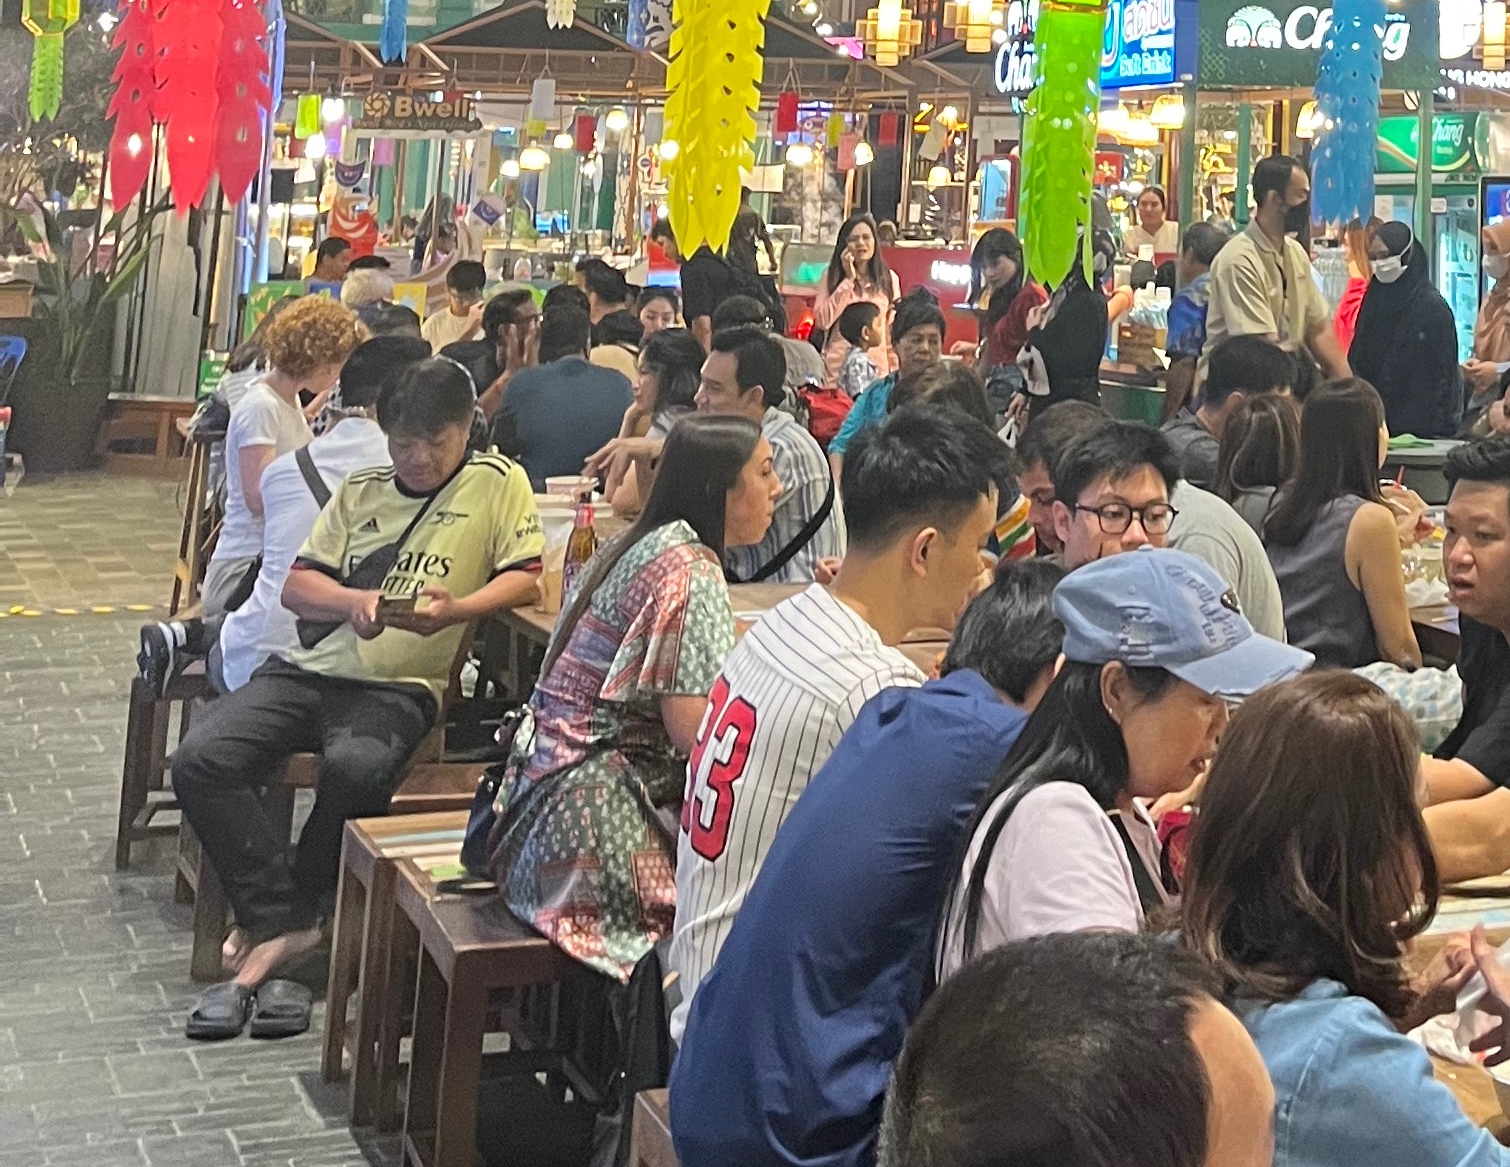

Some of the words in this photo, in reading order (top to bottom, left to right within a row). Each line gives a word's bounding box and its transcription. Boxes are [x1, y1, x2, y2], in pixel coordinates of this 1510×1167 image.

[1284, 5, 1411, 61] Chg
[994, 40, 1040, 94] Cha
[394, 96, 469, 118] Bwell
